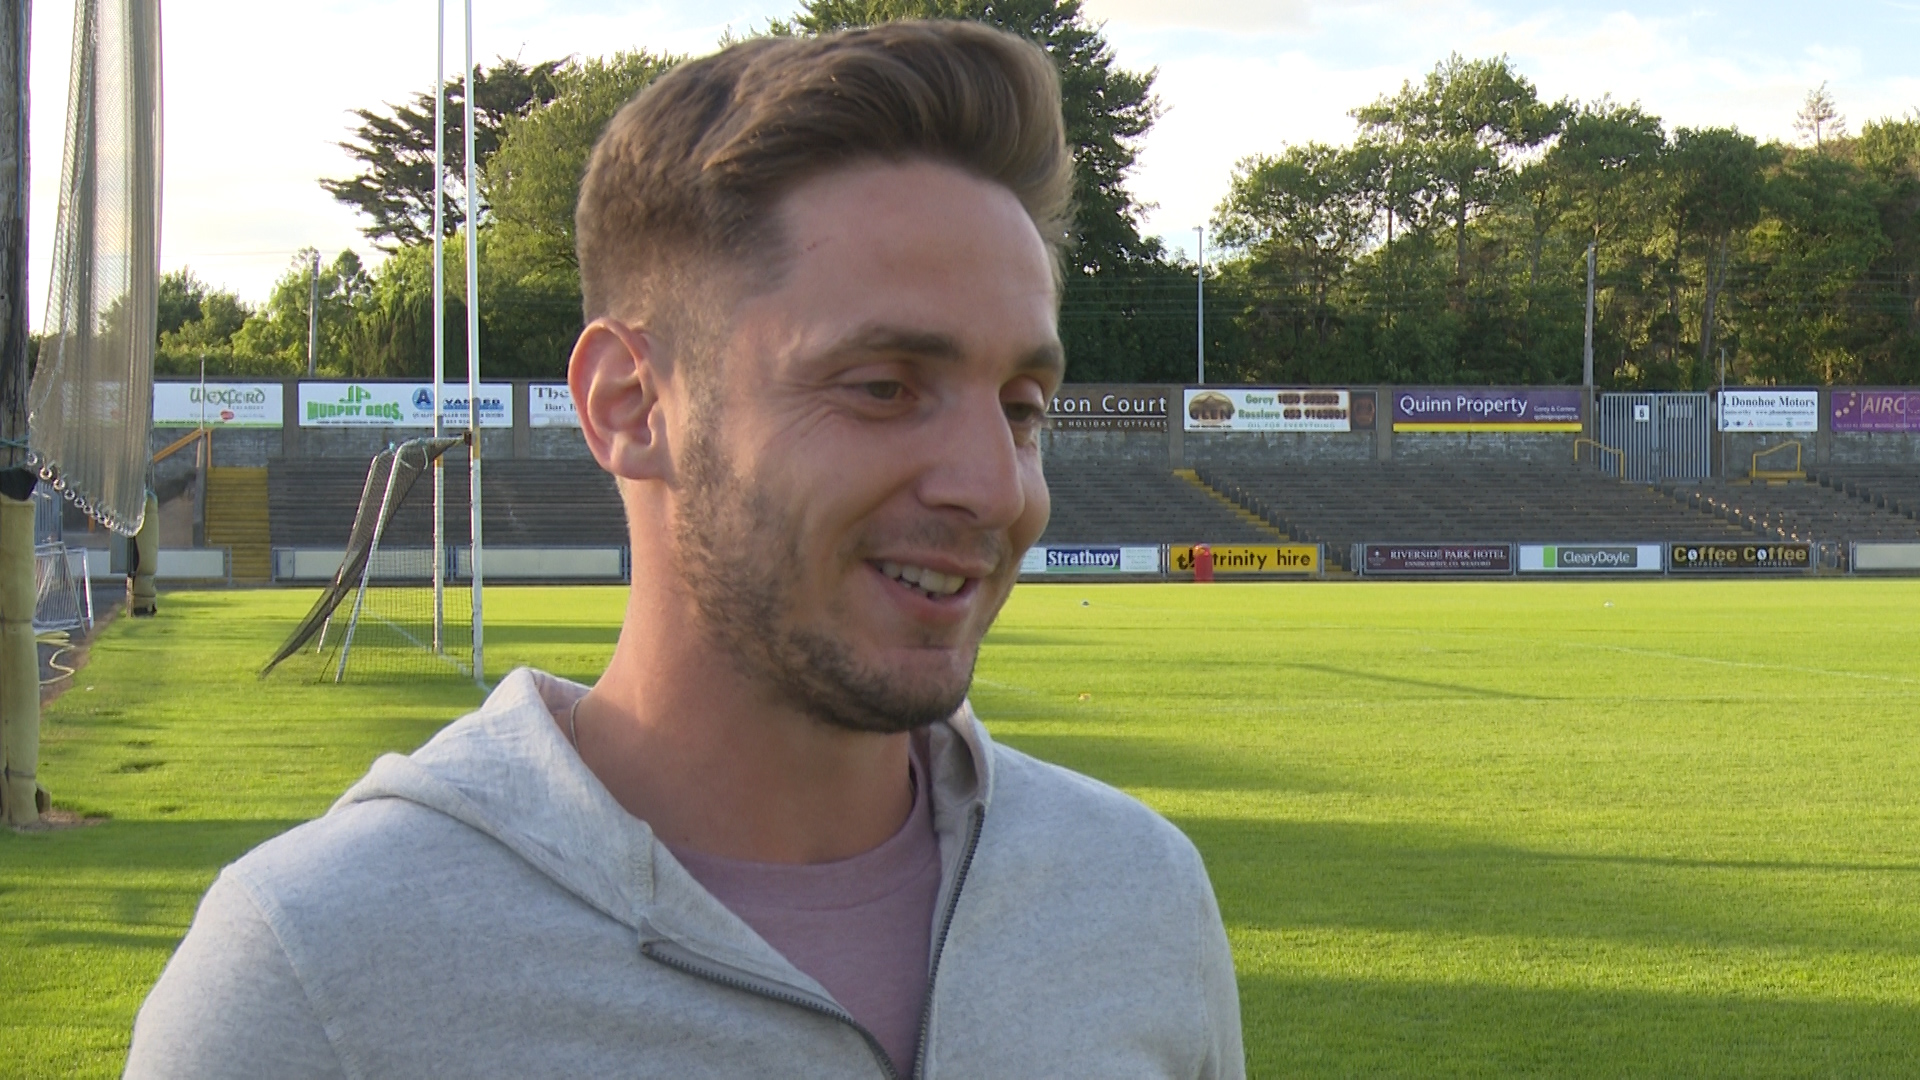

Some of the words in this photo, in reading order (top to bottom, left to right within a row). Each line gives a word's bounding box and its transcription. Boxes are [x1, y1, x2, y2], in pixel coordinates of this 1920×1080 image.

[189, 387, 266, 408] Wexford
[1053, 397, 1091, 412] ton
[1102, 395, 1167, 412] Court
[1245, 394, 1274, 405] Gorey
[1731, 395, 1776, 407] Donohoe
[1779, 395, 1816, 407] Motors
[307, 401, 361, 420] MURPHY
[1400, 395, 1451, 416] Quinn
[1457, 395, 1528, 417] Property
[1238, 409, 1281, 420] Rosslare
[1048, 550, 1119, 568] Strathroy
[1212, 550, 1268, 570] trinity
[1277, 549, 1311, 566] hire
[1390, 549, 1443, 559] RIVERSIDE
[1444, 549, 1471, 559] PARK
[1473, 549, 1507, 560] HOTEL
[1563, 551, 1631, 566] ClearyDoyle
[1673, 547, 1738, 562] Coffee
[1743, 547, 1807, 562] Coffee
